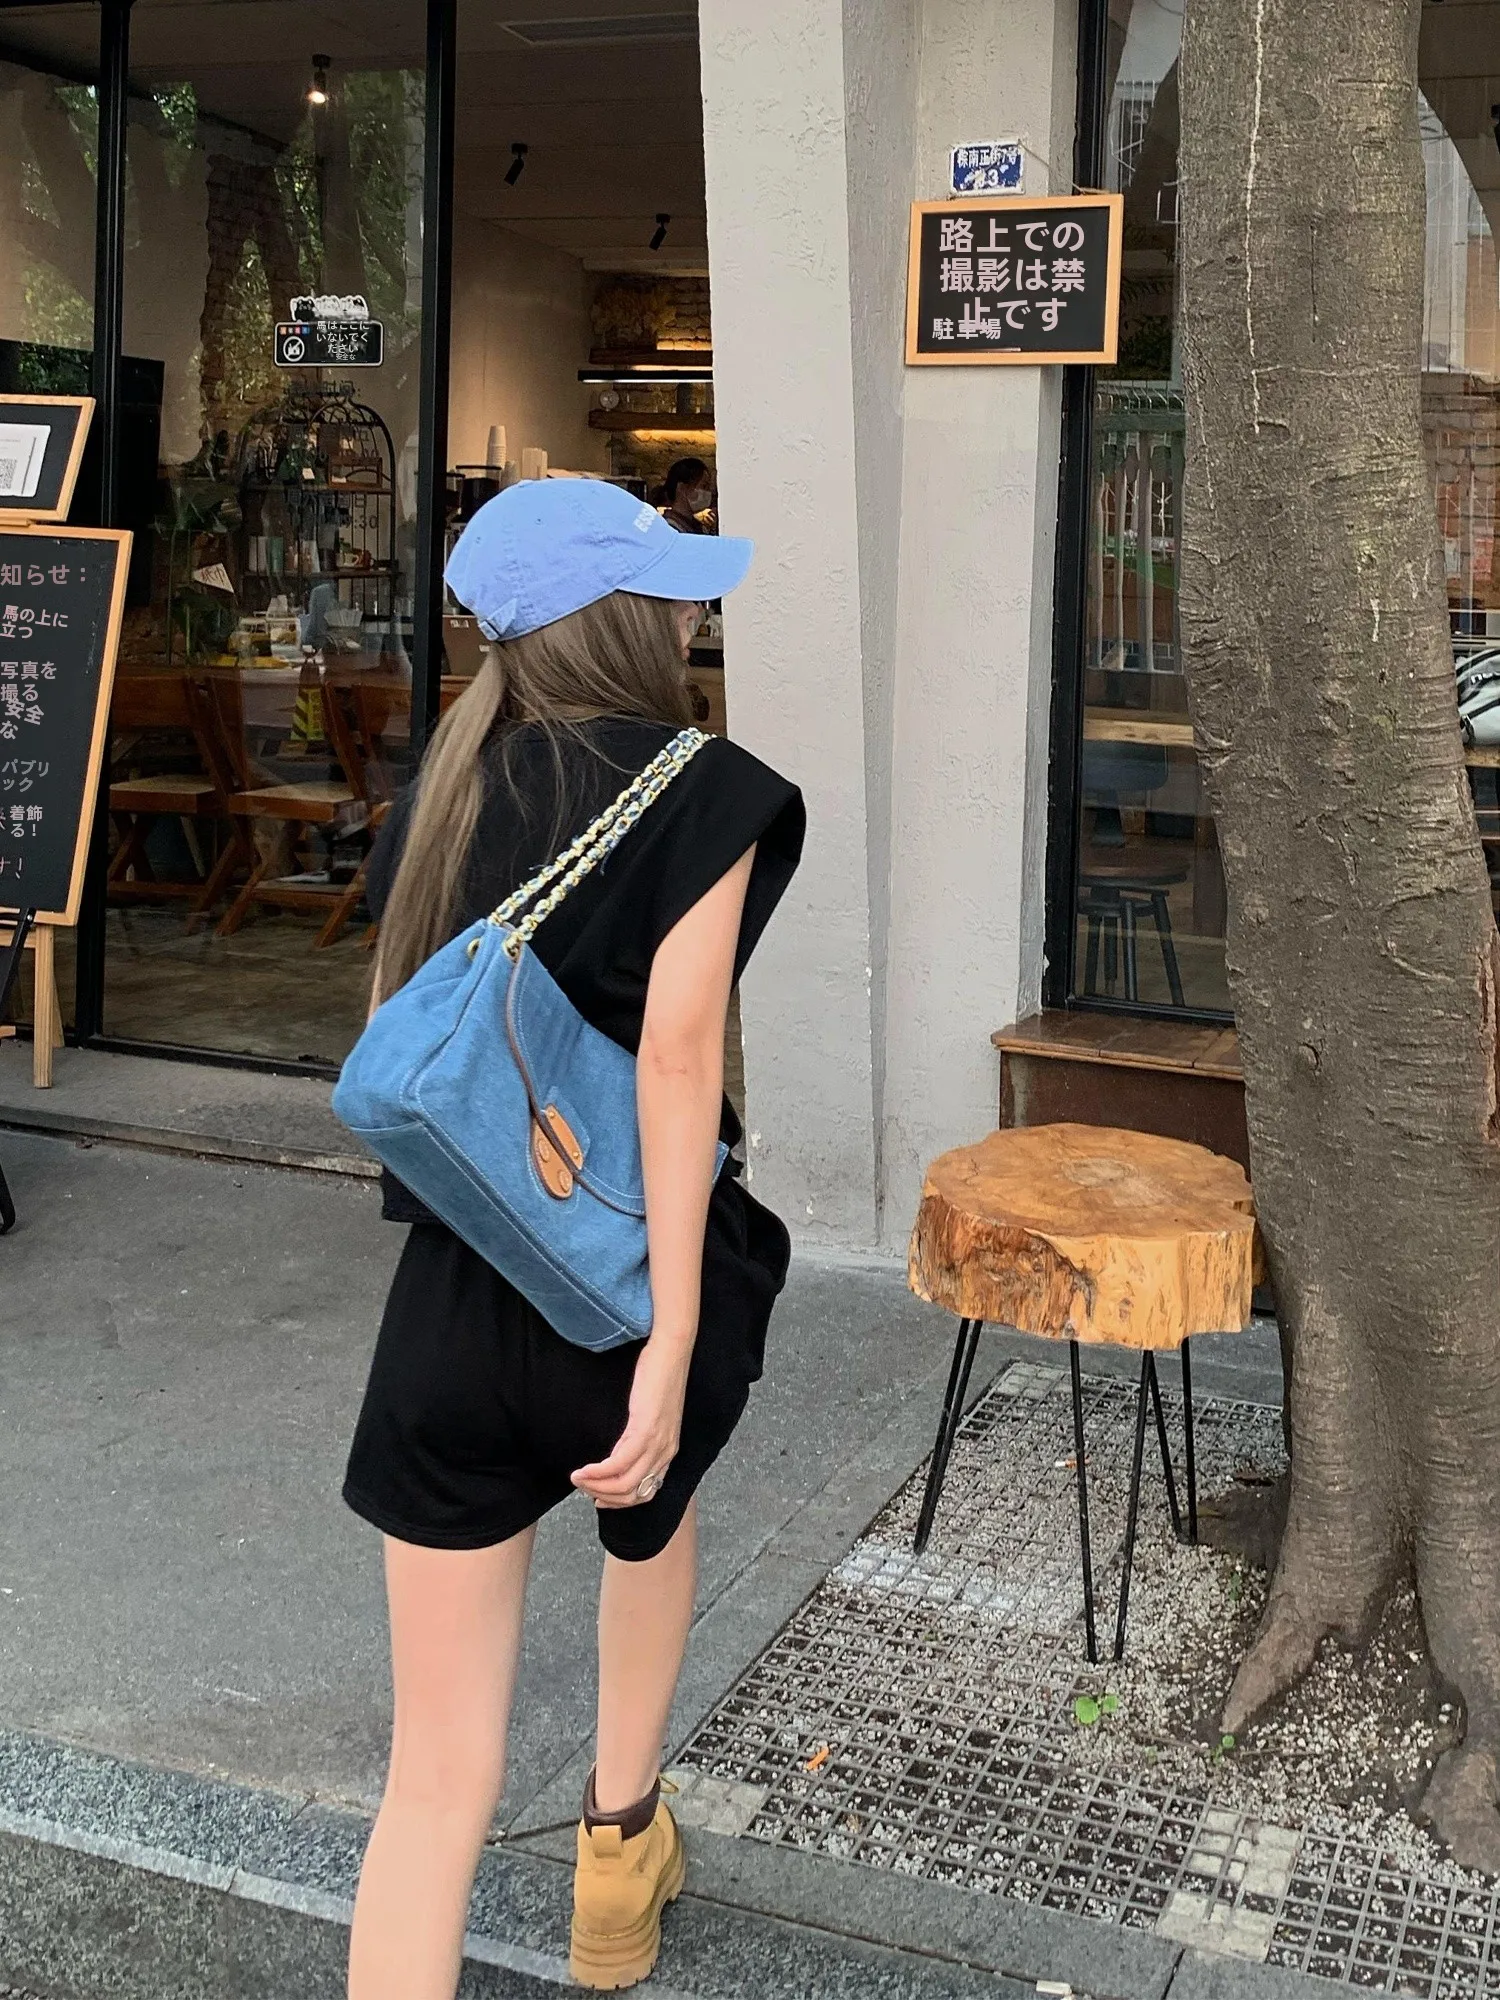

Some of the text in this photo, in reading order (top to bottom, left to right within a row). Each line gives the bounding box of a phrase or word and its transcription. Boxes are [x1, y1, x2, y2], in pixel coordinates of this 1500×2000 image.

[939, 217, 1085, 252] 路上での
[939, 257, 1086, 293] 撮影は禁
[957, 296, 1067, 332] 止です
[316, 320, 370, 331] 馬はここに
[932, 318, 1002, 340] 駐車場
[316, 332, 368, 343] いないでく
[327, 343, 359, 354] ださい
[2, 604, 69, 628] 馬の上に
[0, 621, 33, 639] 立つ
[0, 660, 58, 680] 写真を
[0, 683, 39, 702] 撮る
[4, 698, 45, 725] 安全
[0, 720, 19, 740] な
[1, 758, 50, 778] パブリ
[9, 804, 44, 822] 着飾
